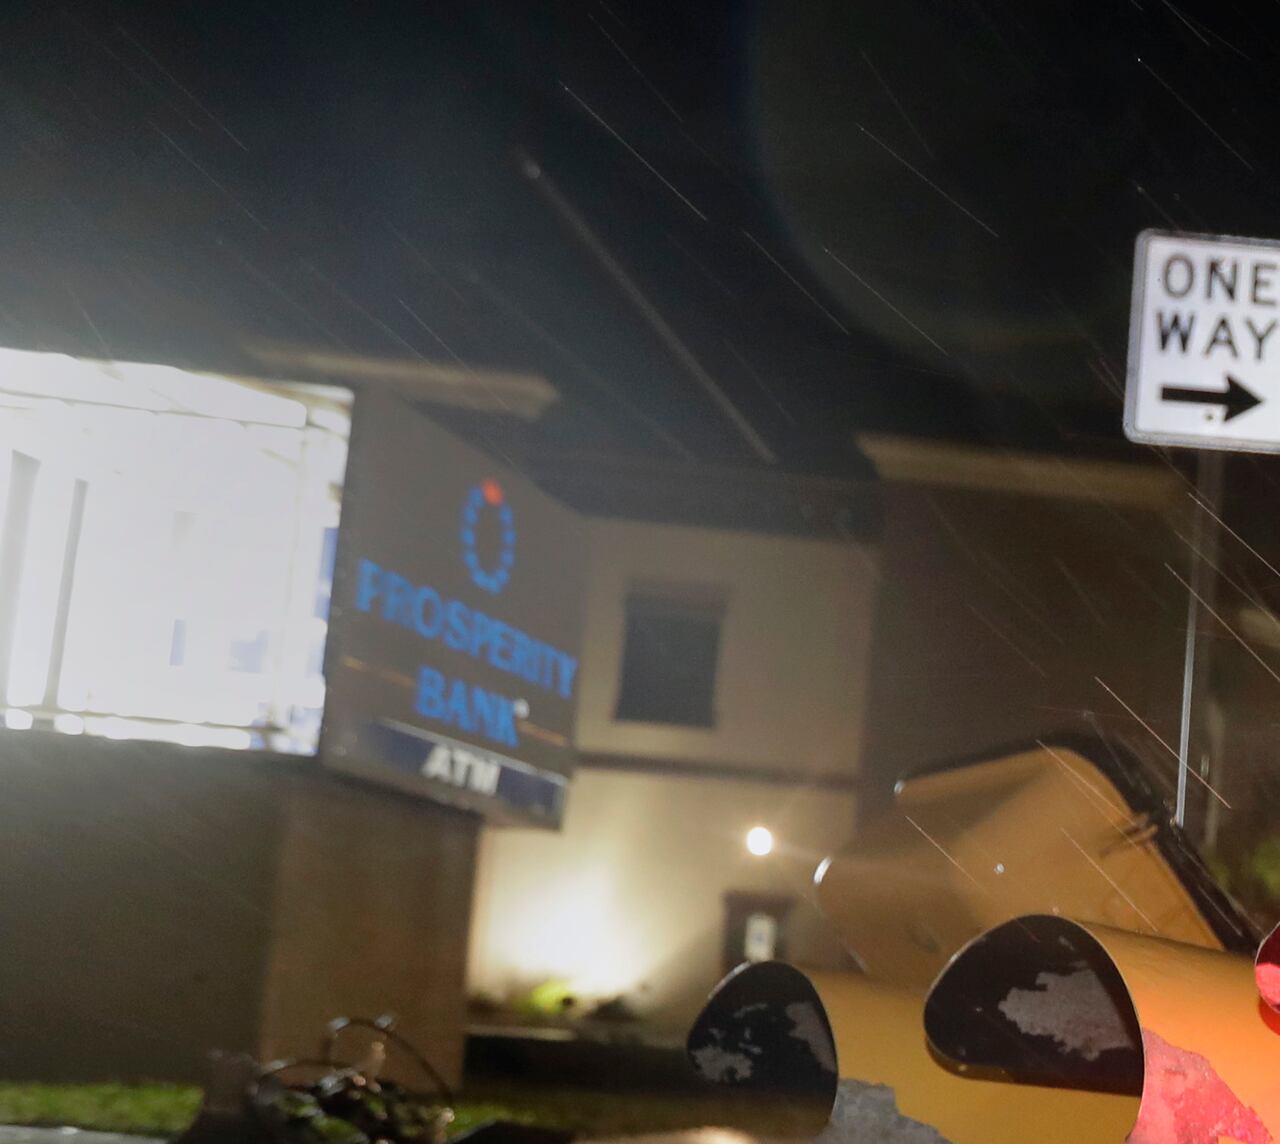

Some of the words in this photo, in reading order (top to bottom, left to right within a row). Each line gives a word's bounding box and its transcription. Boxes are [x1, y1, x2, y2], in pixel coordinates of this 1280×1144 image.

[1163, 254, 1279, 306] ONE
[1156, 311, 1279, 361] WAY
[355, 557, 578, 700] PROSPERITY
[415, 664, 519, 747] BANK
[421, 743, 501, 797] ATM
